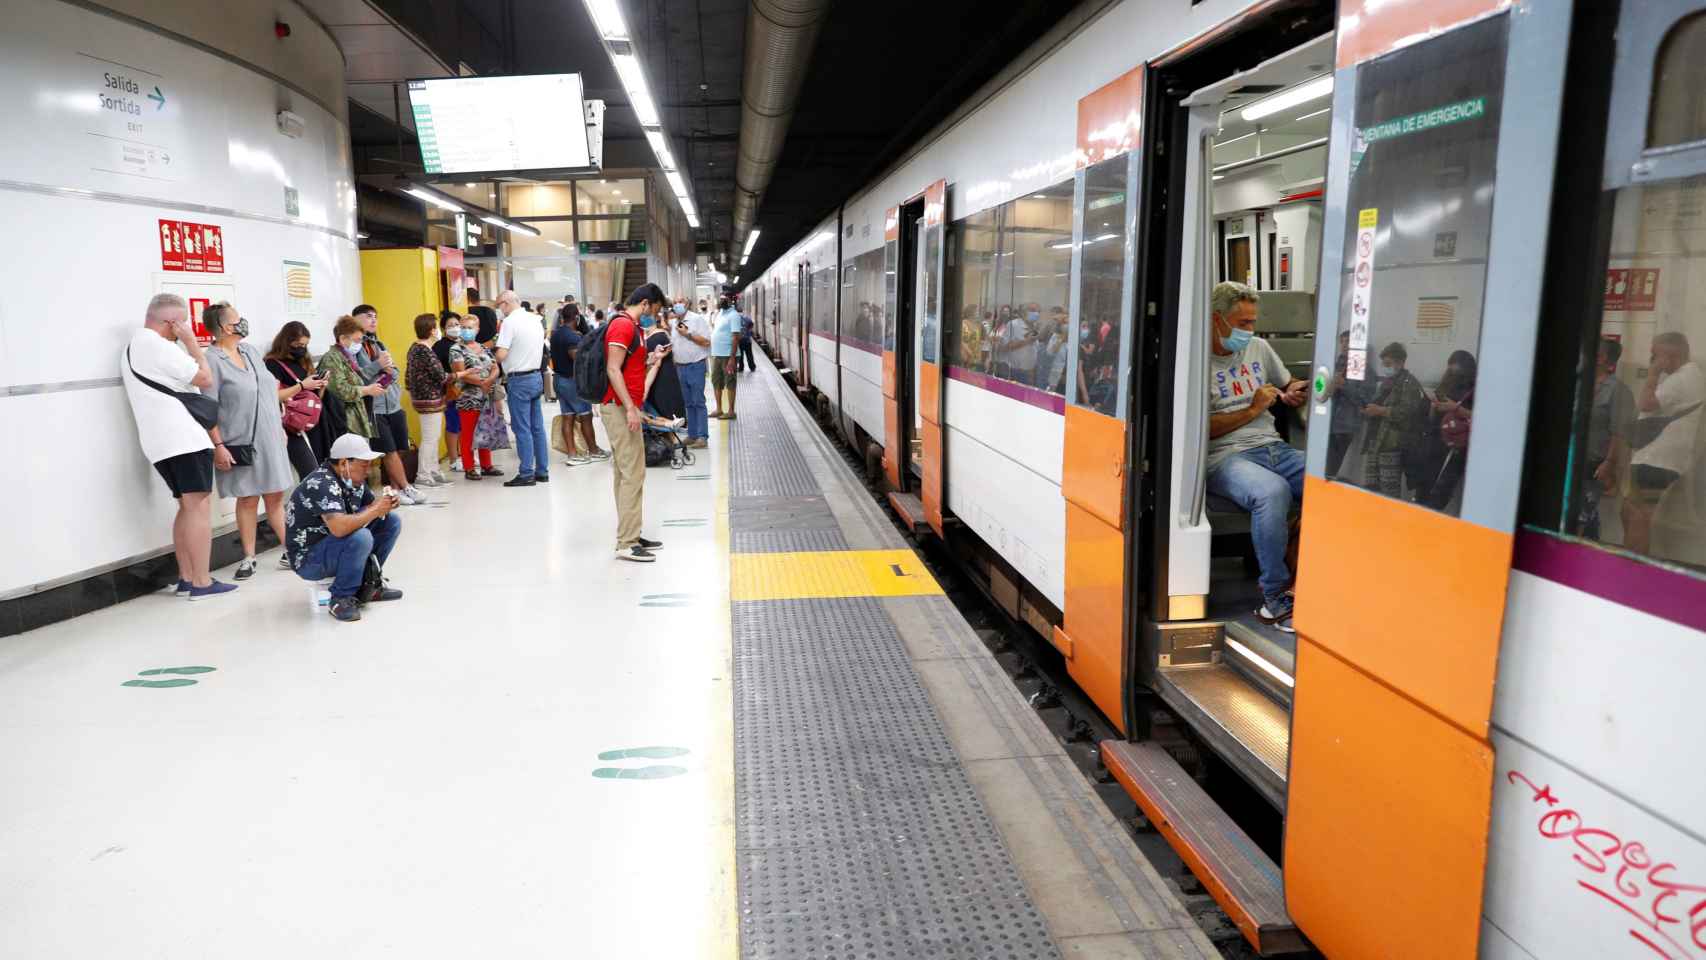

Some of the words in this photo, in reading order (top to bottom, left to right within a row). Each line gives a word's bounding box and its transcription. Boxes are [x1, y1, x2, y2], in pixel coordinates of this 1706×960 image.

[104, 72, 139, 94] Salida
[99, 92, 141, 116] Sortida
[1362, 121, 1401, 141] VENTANA
[1402, 117, 1416, 133] DE
[1417, 99, 1482, 128] EMERGENCIA
[1216, 361, 1262, 384] STAR
